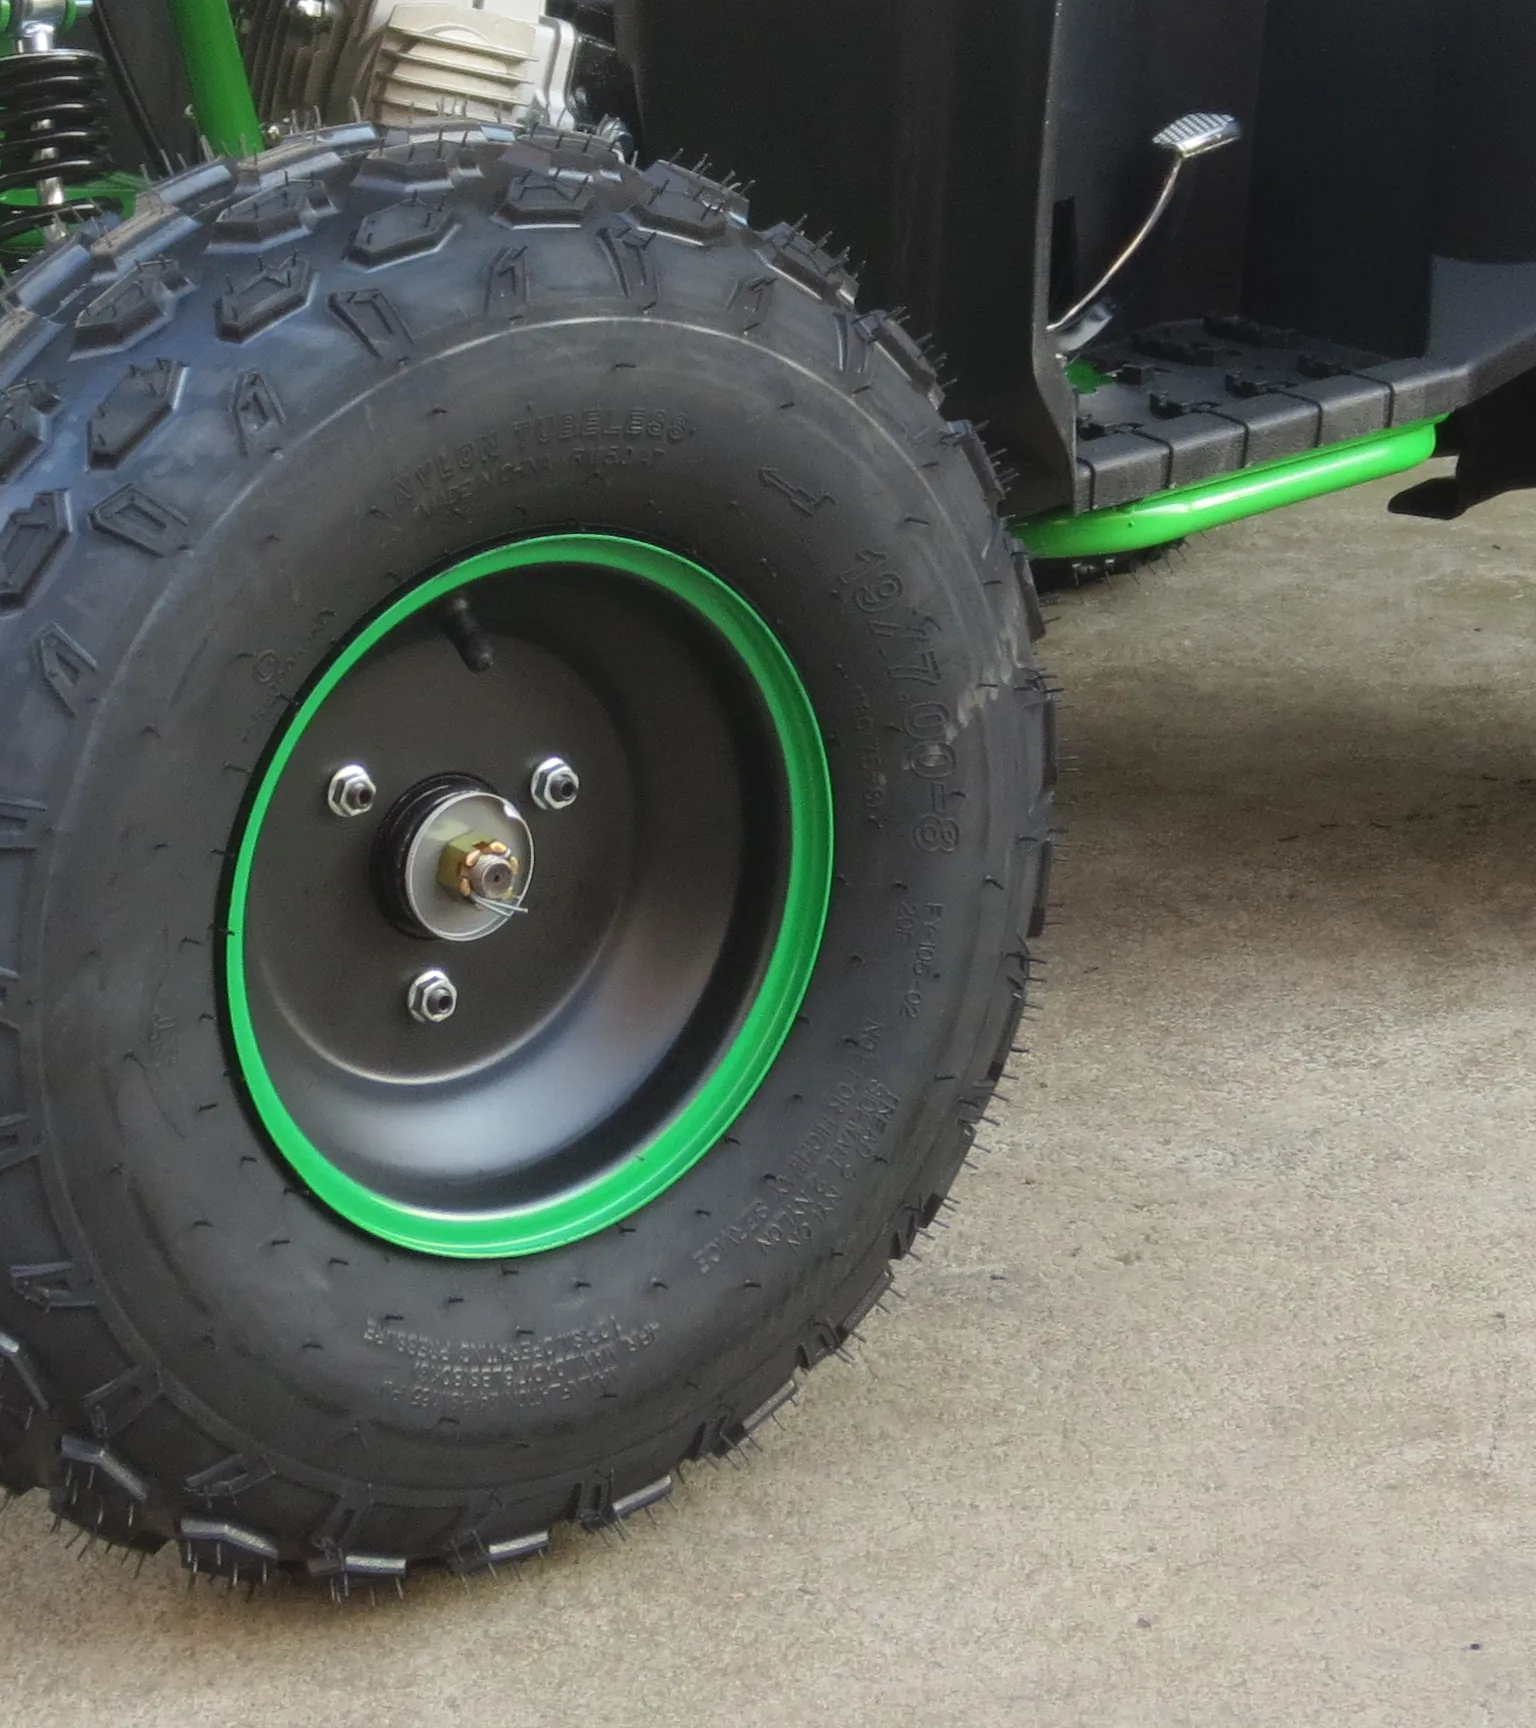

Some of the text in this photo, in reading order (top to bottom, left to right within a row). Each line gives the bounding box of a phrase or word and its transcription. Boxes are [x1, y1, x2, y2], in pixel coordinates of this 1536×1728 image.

[392, 430, 500, 506] NYLON
[514, 404, 689, 450] TUBELESS
[692, 1193, 771, 1275] SERVICE
